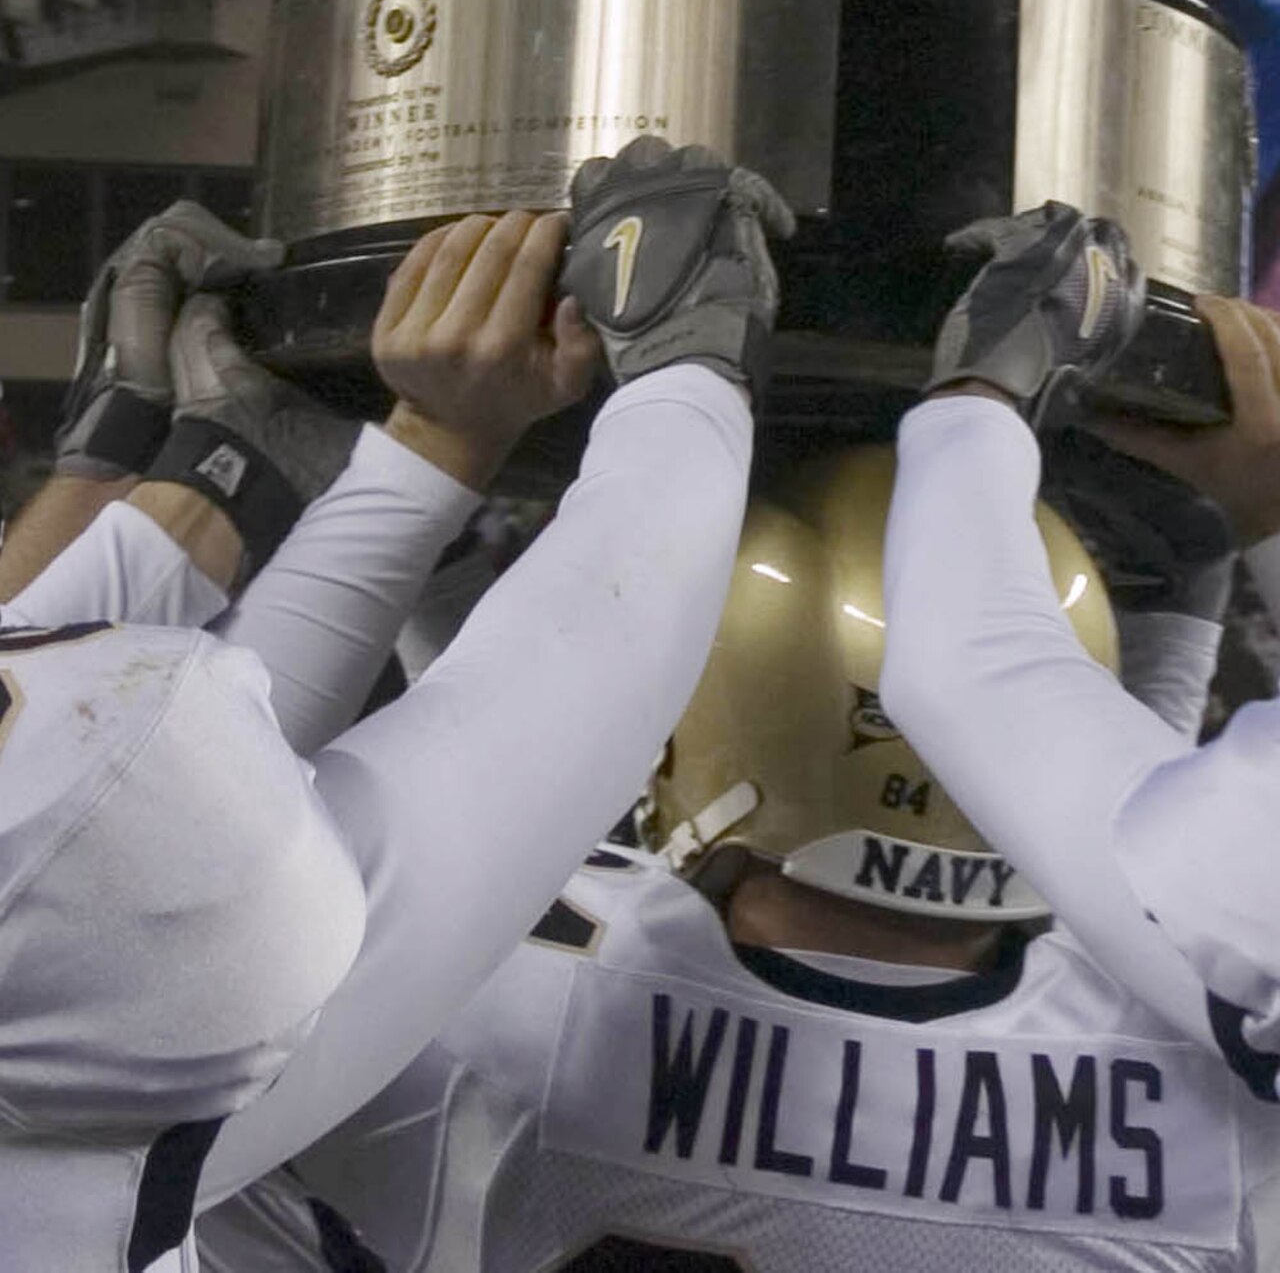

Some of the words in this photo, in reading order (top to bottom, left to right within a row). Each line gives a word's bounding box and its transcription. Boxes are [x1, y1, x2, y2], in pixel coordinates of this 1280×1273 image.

[880, 773, 931, 817] 84
[854, 837, 1016, 907] NAVY
[643, 993, 1164, 1221] WILLIAMS
